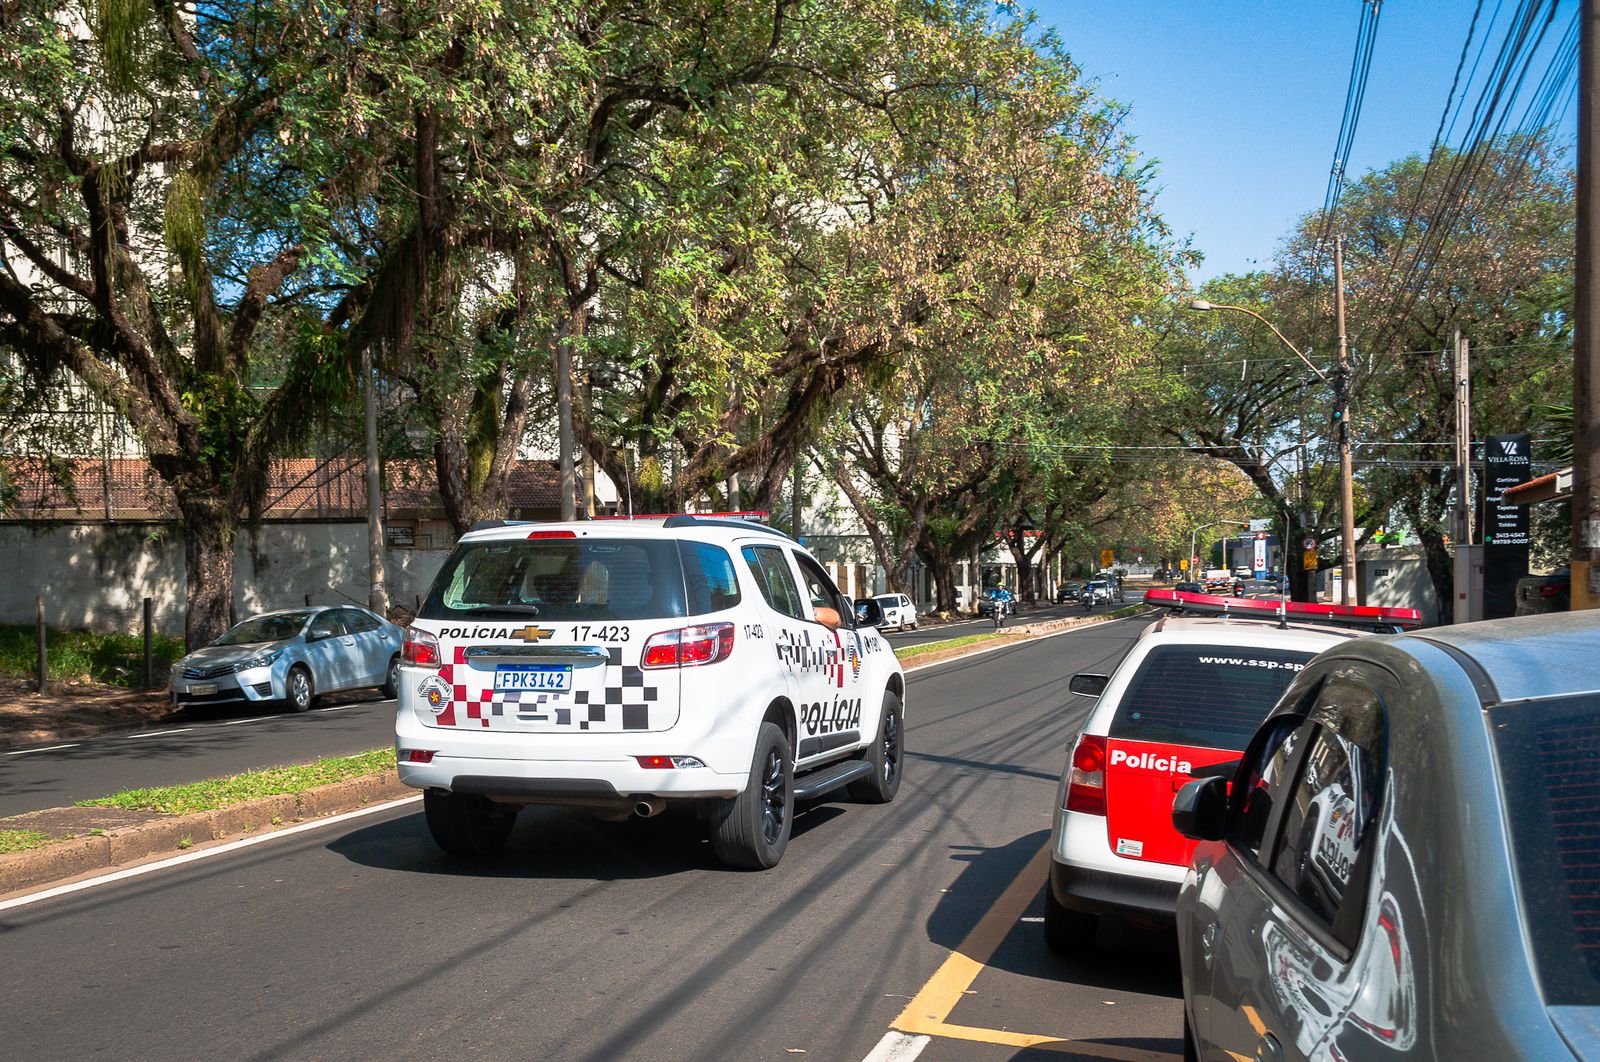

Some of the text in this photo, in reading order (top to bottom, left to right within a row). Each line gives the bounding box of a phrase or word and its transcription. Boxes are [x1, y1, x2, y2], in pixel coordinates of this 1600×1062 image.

[438, 625, 508, 639] POLÍCIA
[570, 625, 630, 642] 17-423
[1199, 656, 1305, 672] www.ssp.sp
[502, 672, 564, 688] FPK3I42
[800, 693, 861, 736] POLÍCIA
[1110, 749, 1192, 774] Polícia
